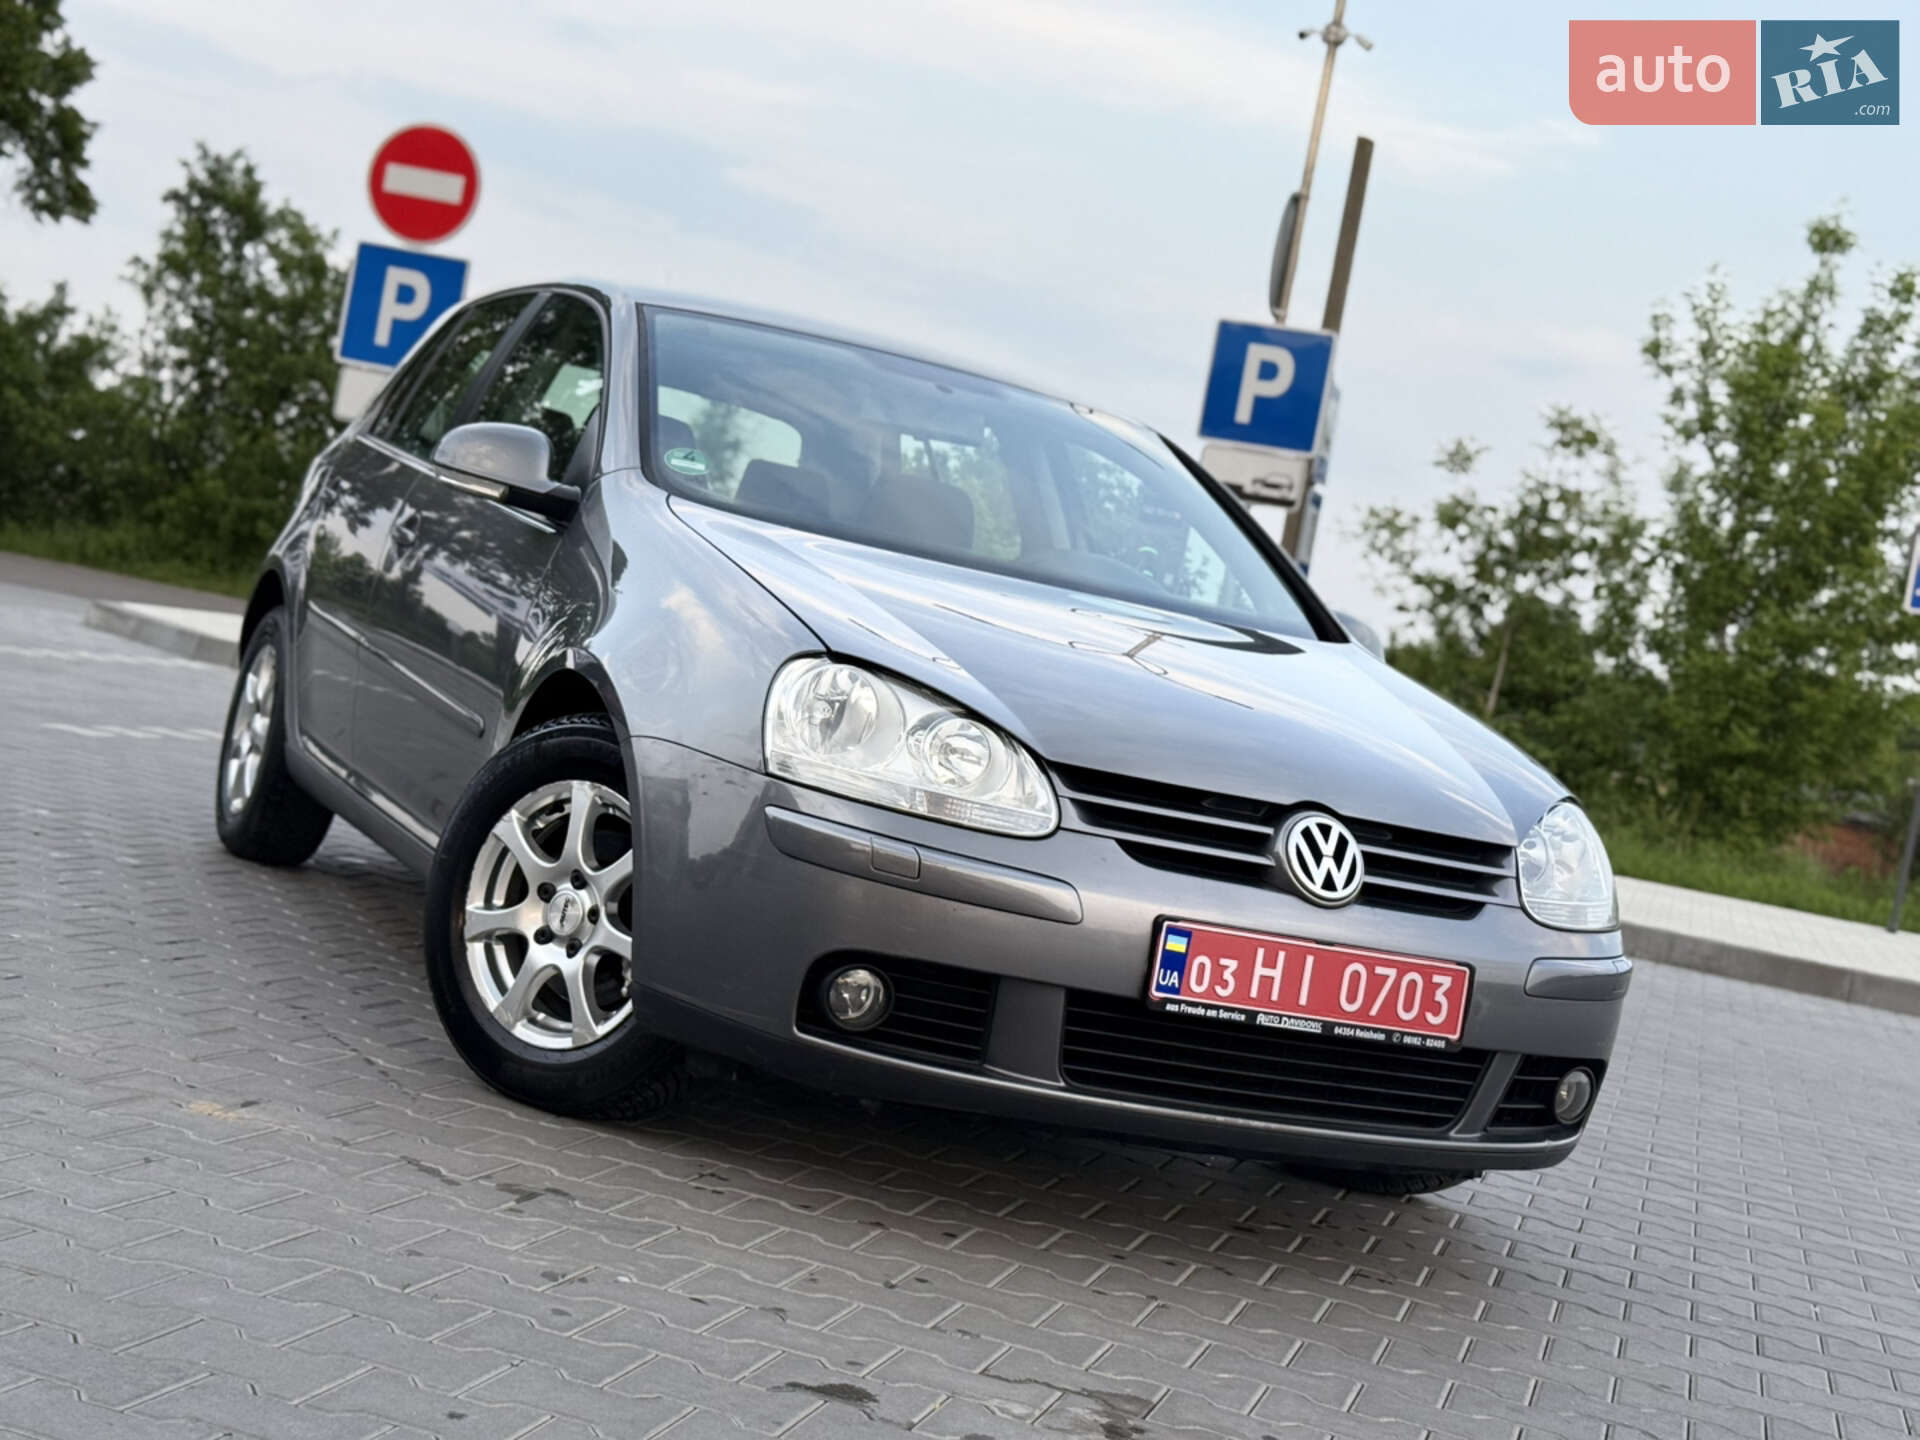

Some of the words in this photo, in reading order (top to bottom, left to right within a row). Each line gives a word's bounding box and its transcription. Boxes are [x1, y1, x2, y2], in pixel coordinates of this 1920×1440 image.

[374, 265, 432, 348] P
[1234, 342, 1296, 425] P
[1284, 814, 1361, 898] VW
[1159, 969, 1179, 988] UA
[1189, 955, 1238, 998] 03
[1249, 947, 1315, 1006] HI
[1338, 962, 1452, 1025] 0703
